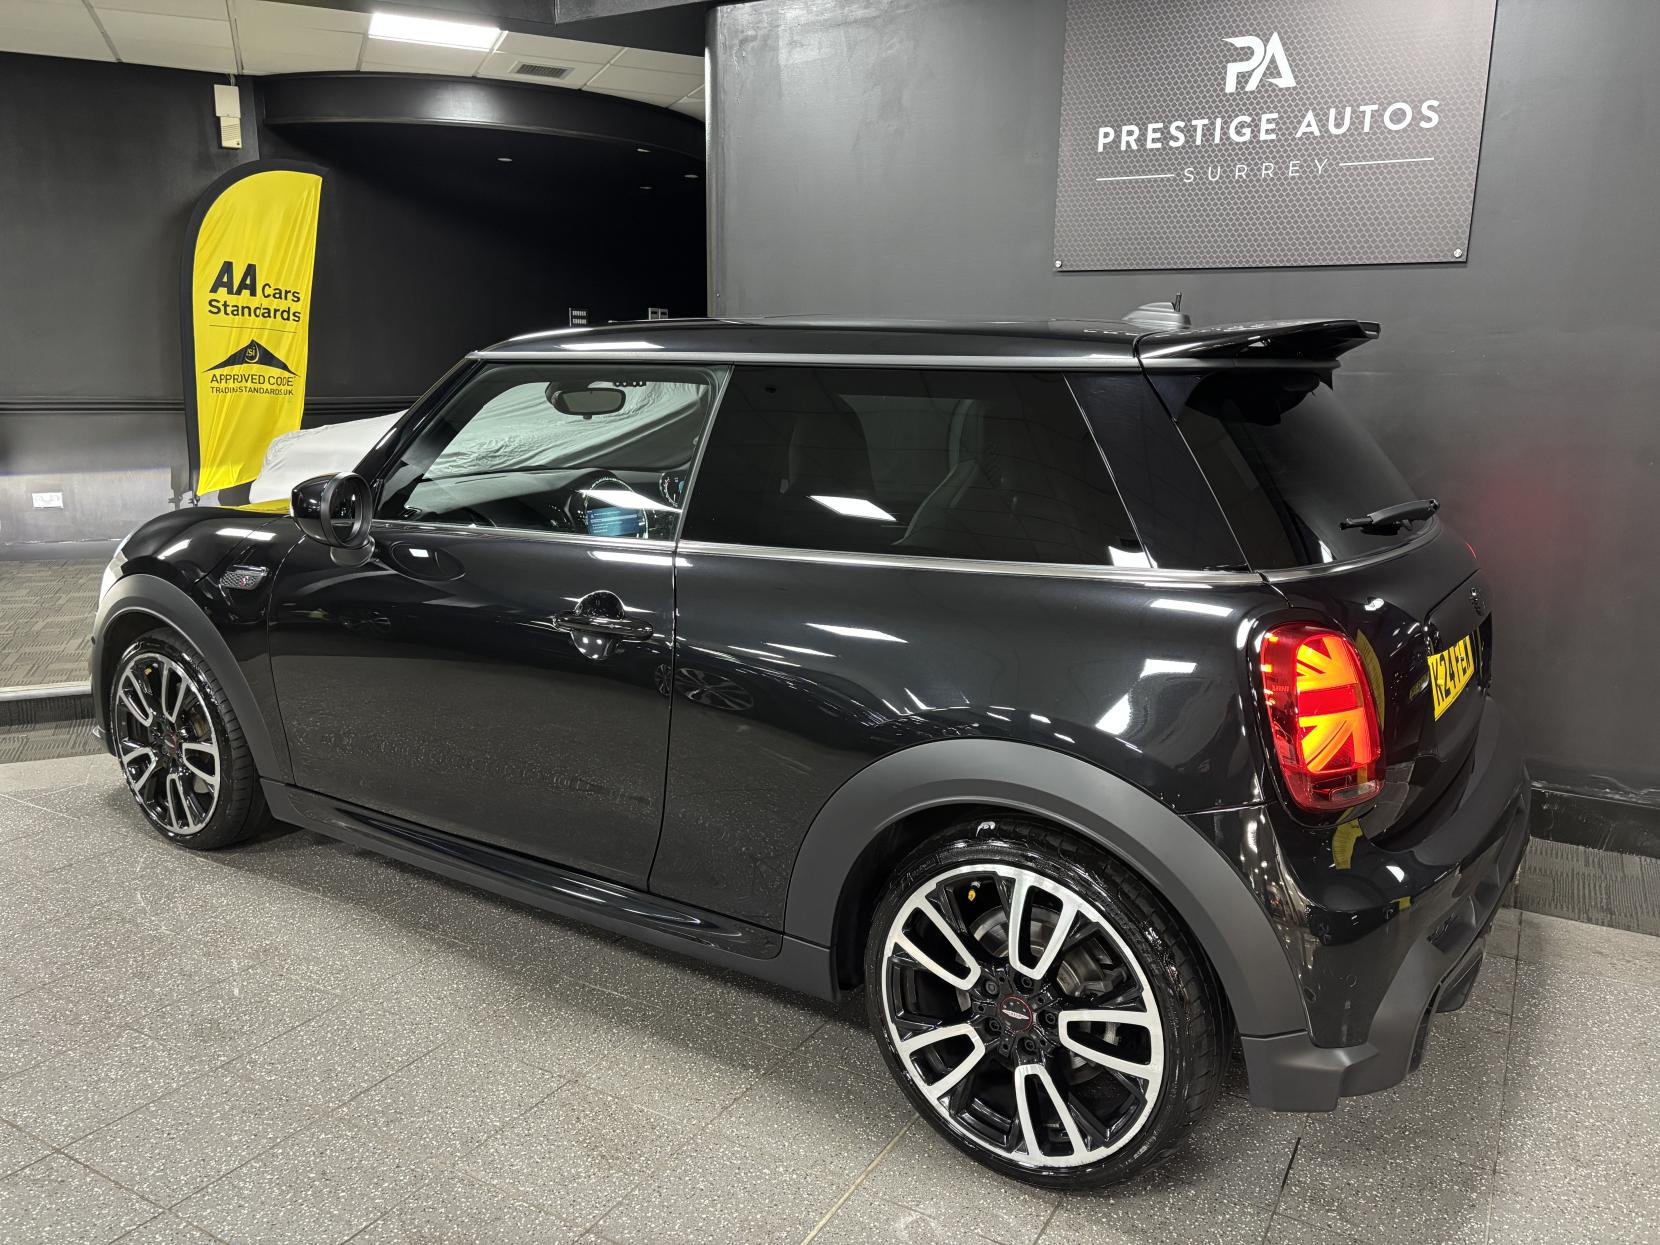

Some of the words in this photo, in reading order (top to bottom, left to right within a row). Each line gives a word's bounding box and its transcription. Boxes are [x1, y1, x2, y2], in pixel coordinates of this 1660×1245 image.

[1221, 31, 1296, 93] PA
[1097, 112, 1279, 152] PRESTIGE
[1296, 99, 1440, 138] AUTOS
[1183, 158, 1328, 183] SURREY
[209, 260, 257, 297] AA
[262, 283, 301, 303] Cars
[208, 298, 301, 322] Standards
[210, 374, 266, 385] APPROVED
[268, 375, 294, 387] CODE
